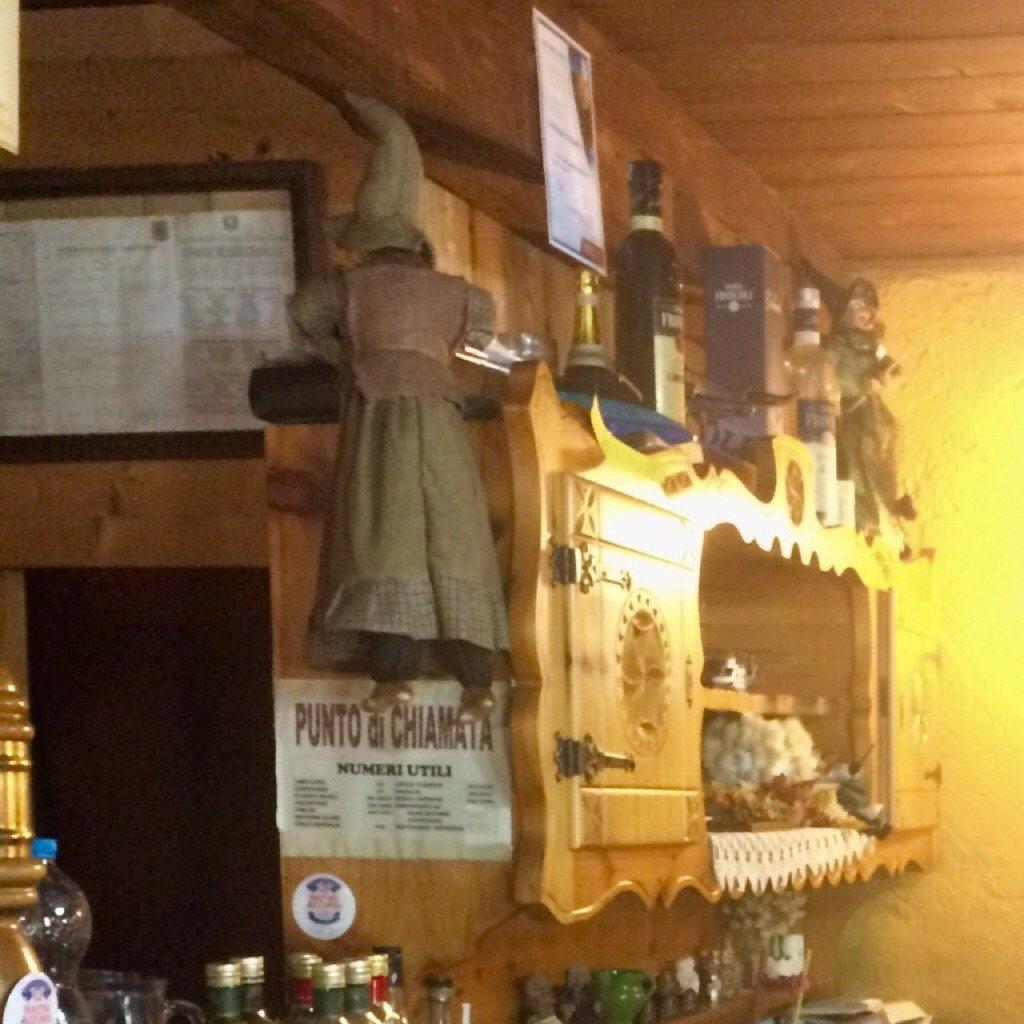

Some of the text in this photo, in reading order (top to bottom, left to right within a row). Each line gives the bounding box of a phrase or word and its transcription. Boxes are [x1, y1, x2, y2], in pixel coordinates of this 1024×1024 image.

[295, 702, 362, 748] PUNTO
[337, 763, 453, 778] NUMERI UTILI
